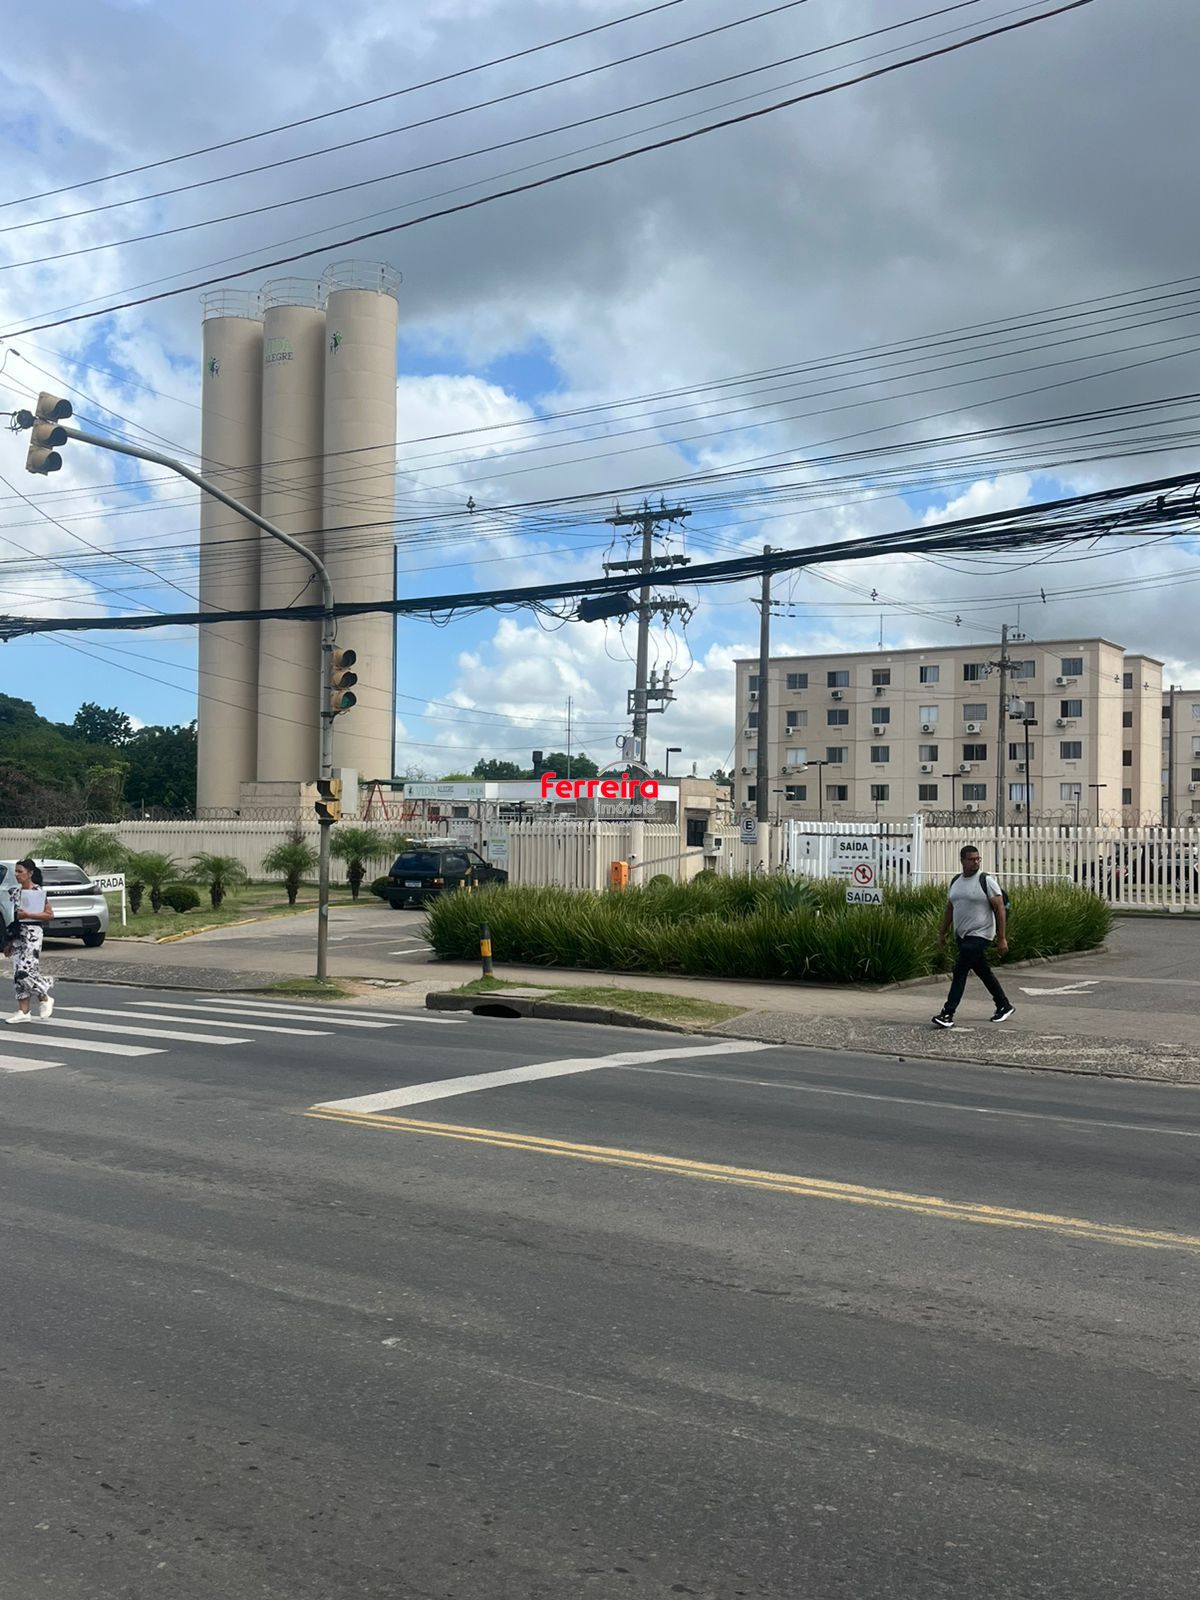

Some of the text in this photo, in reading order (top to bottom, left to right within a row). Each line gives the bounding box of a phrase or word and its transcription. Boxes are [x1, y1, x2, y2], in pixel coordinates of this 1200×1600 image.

[414, 786, 436, 796] VIDA
[745, 820, 752, 829] E
[840, 840, 868, 851] SAÍDA
[93, 877, 124, 888] TRADA
[847, 889, 880, 903] SAÍDA
